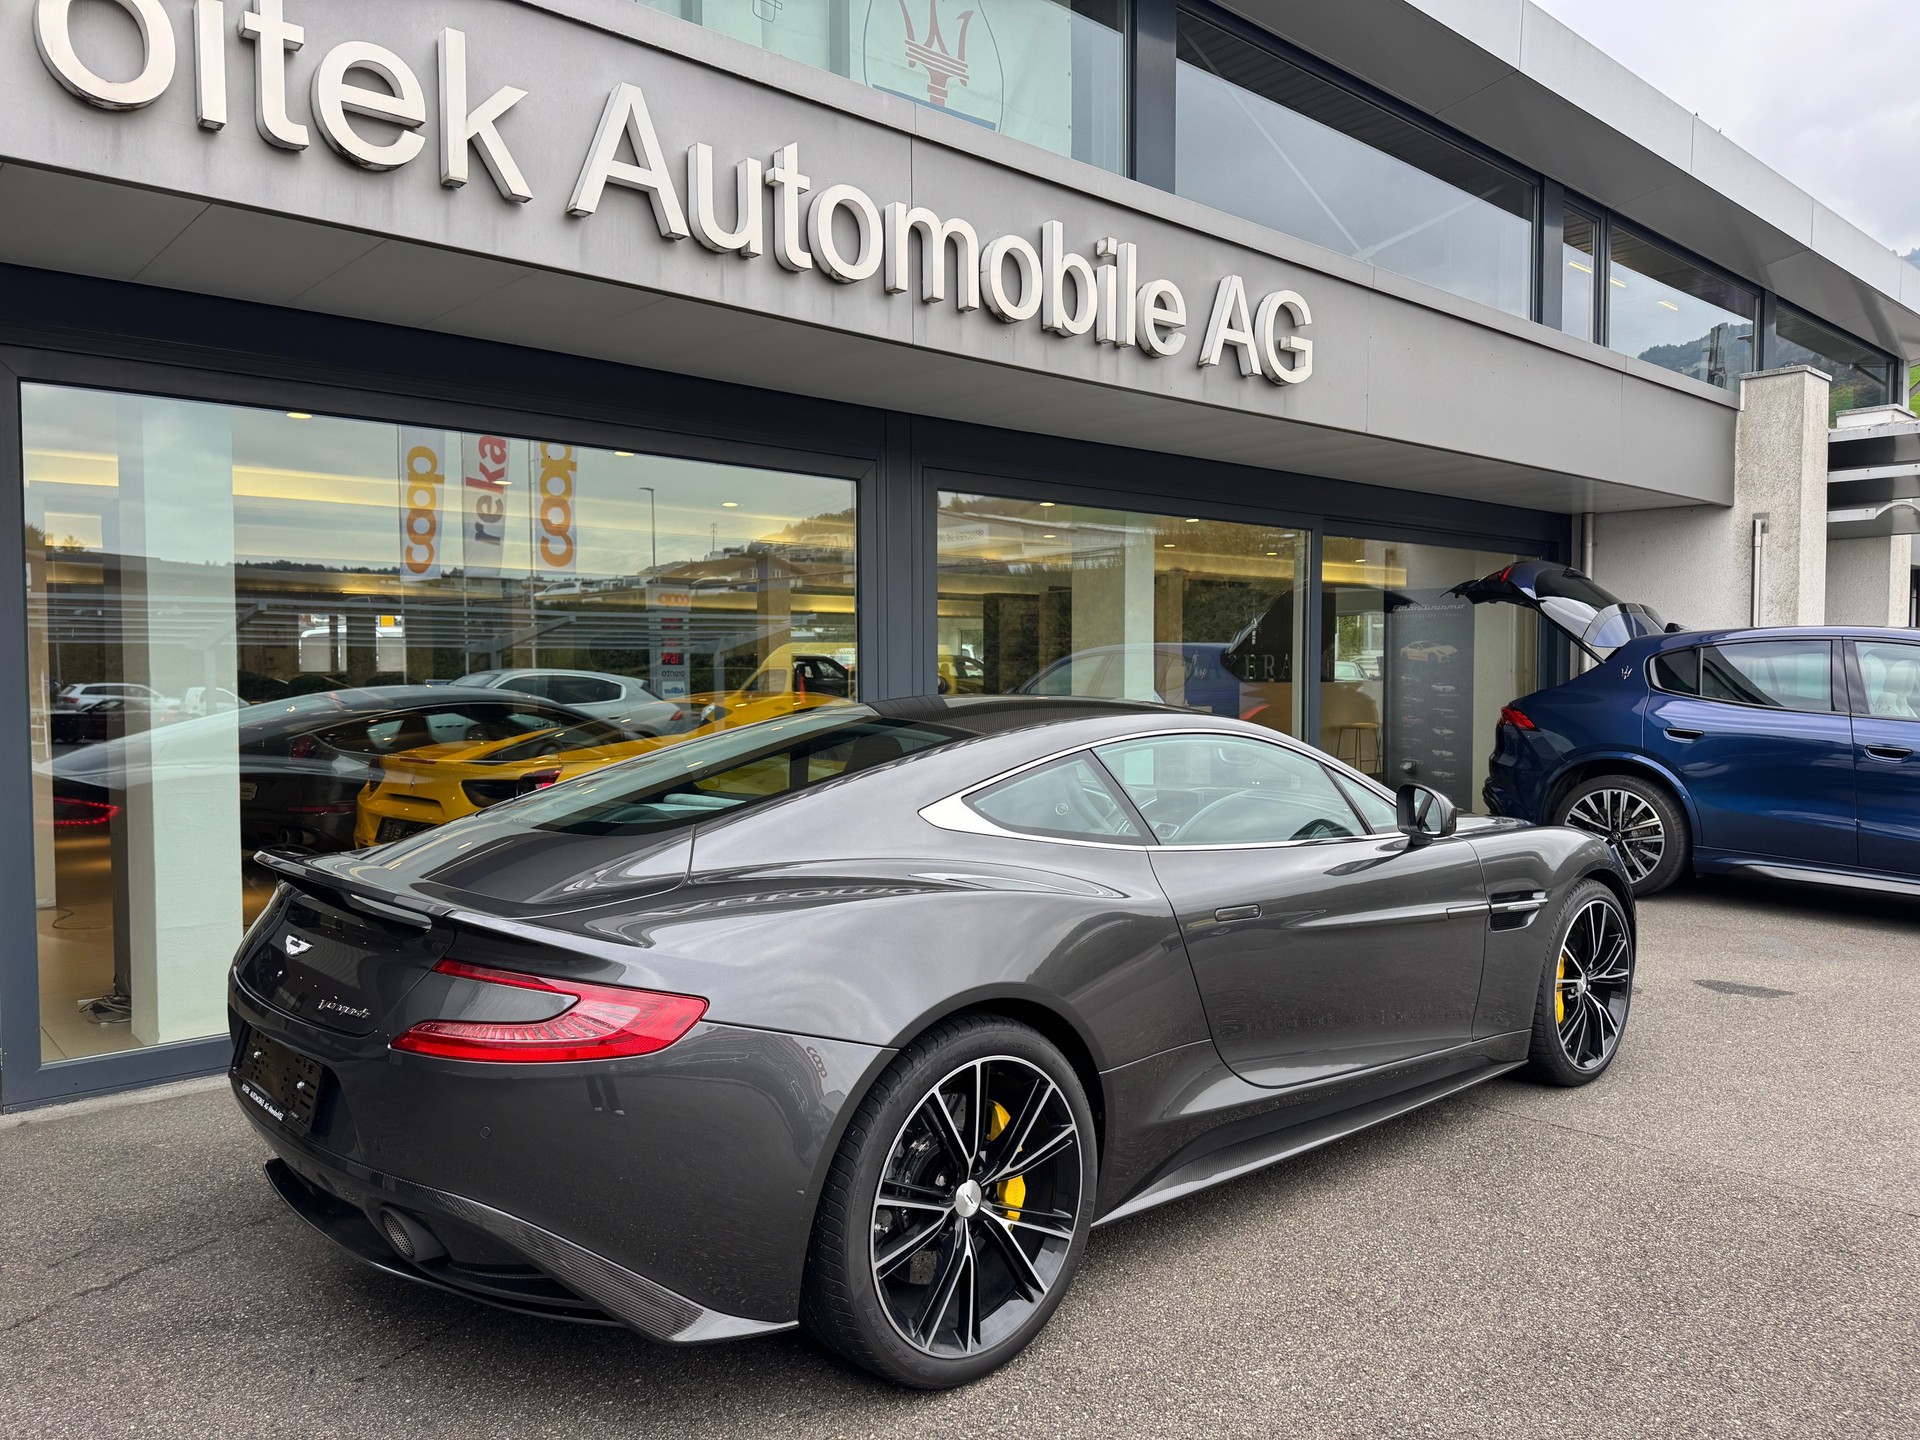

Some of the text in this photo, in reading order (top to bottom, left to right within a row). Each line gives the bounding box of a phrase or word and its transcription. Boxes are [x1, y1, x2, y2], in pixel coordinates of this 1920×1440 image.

[566, 82, 1186, 358] Automobile
[1198, 275, 1312, 385] AG
[405, 446, 445, 574] coop
[465, 435, 507, 546] reka
[539, 441, 577, 567] coop
[805, 1046, 828, 1078] coop
